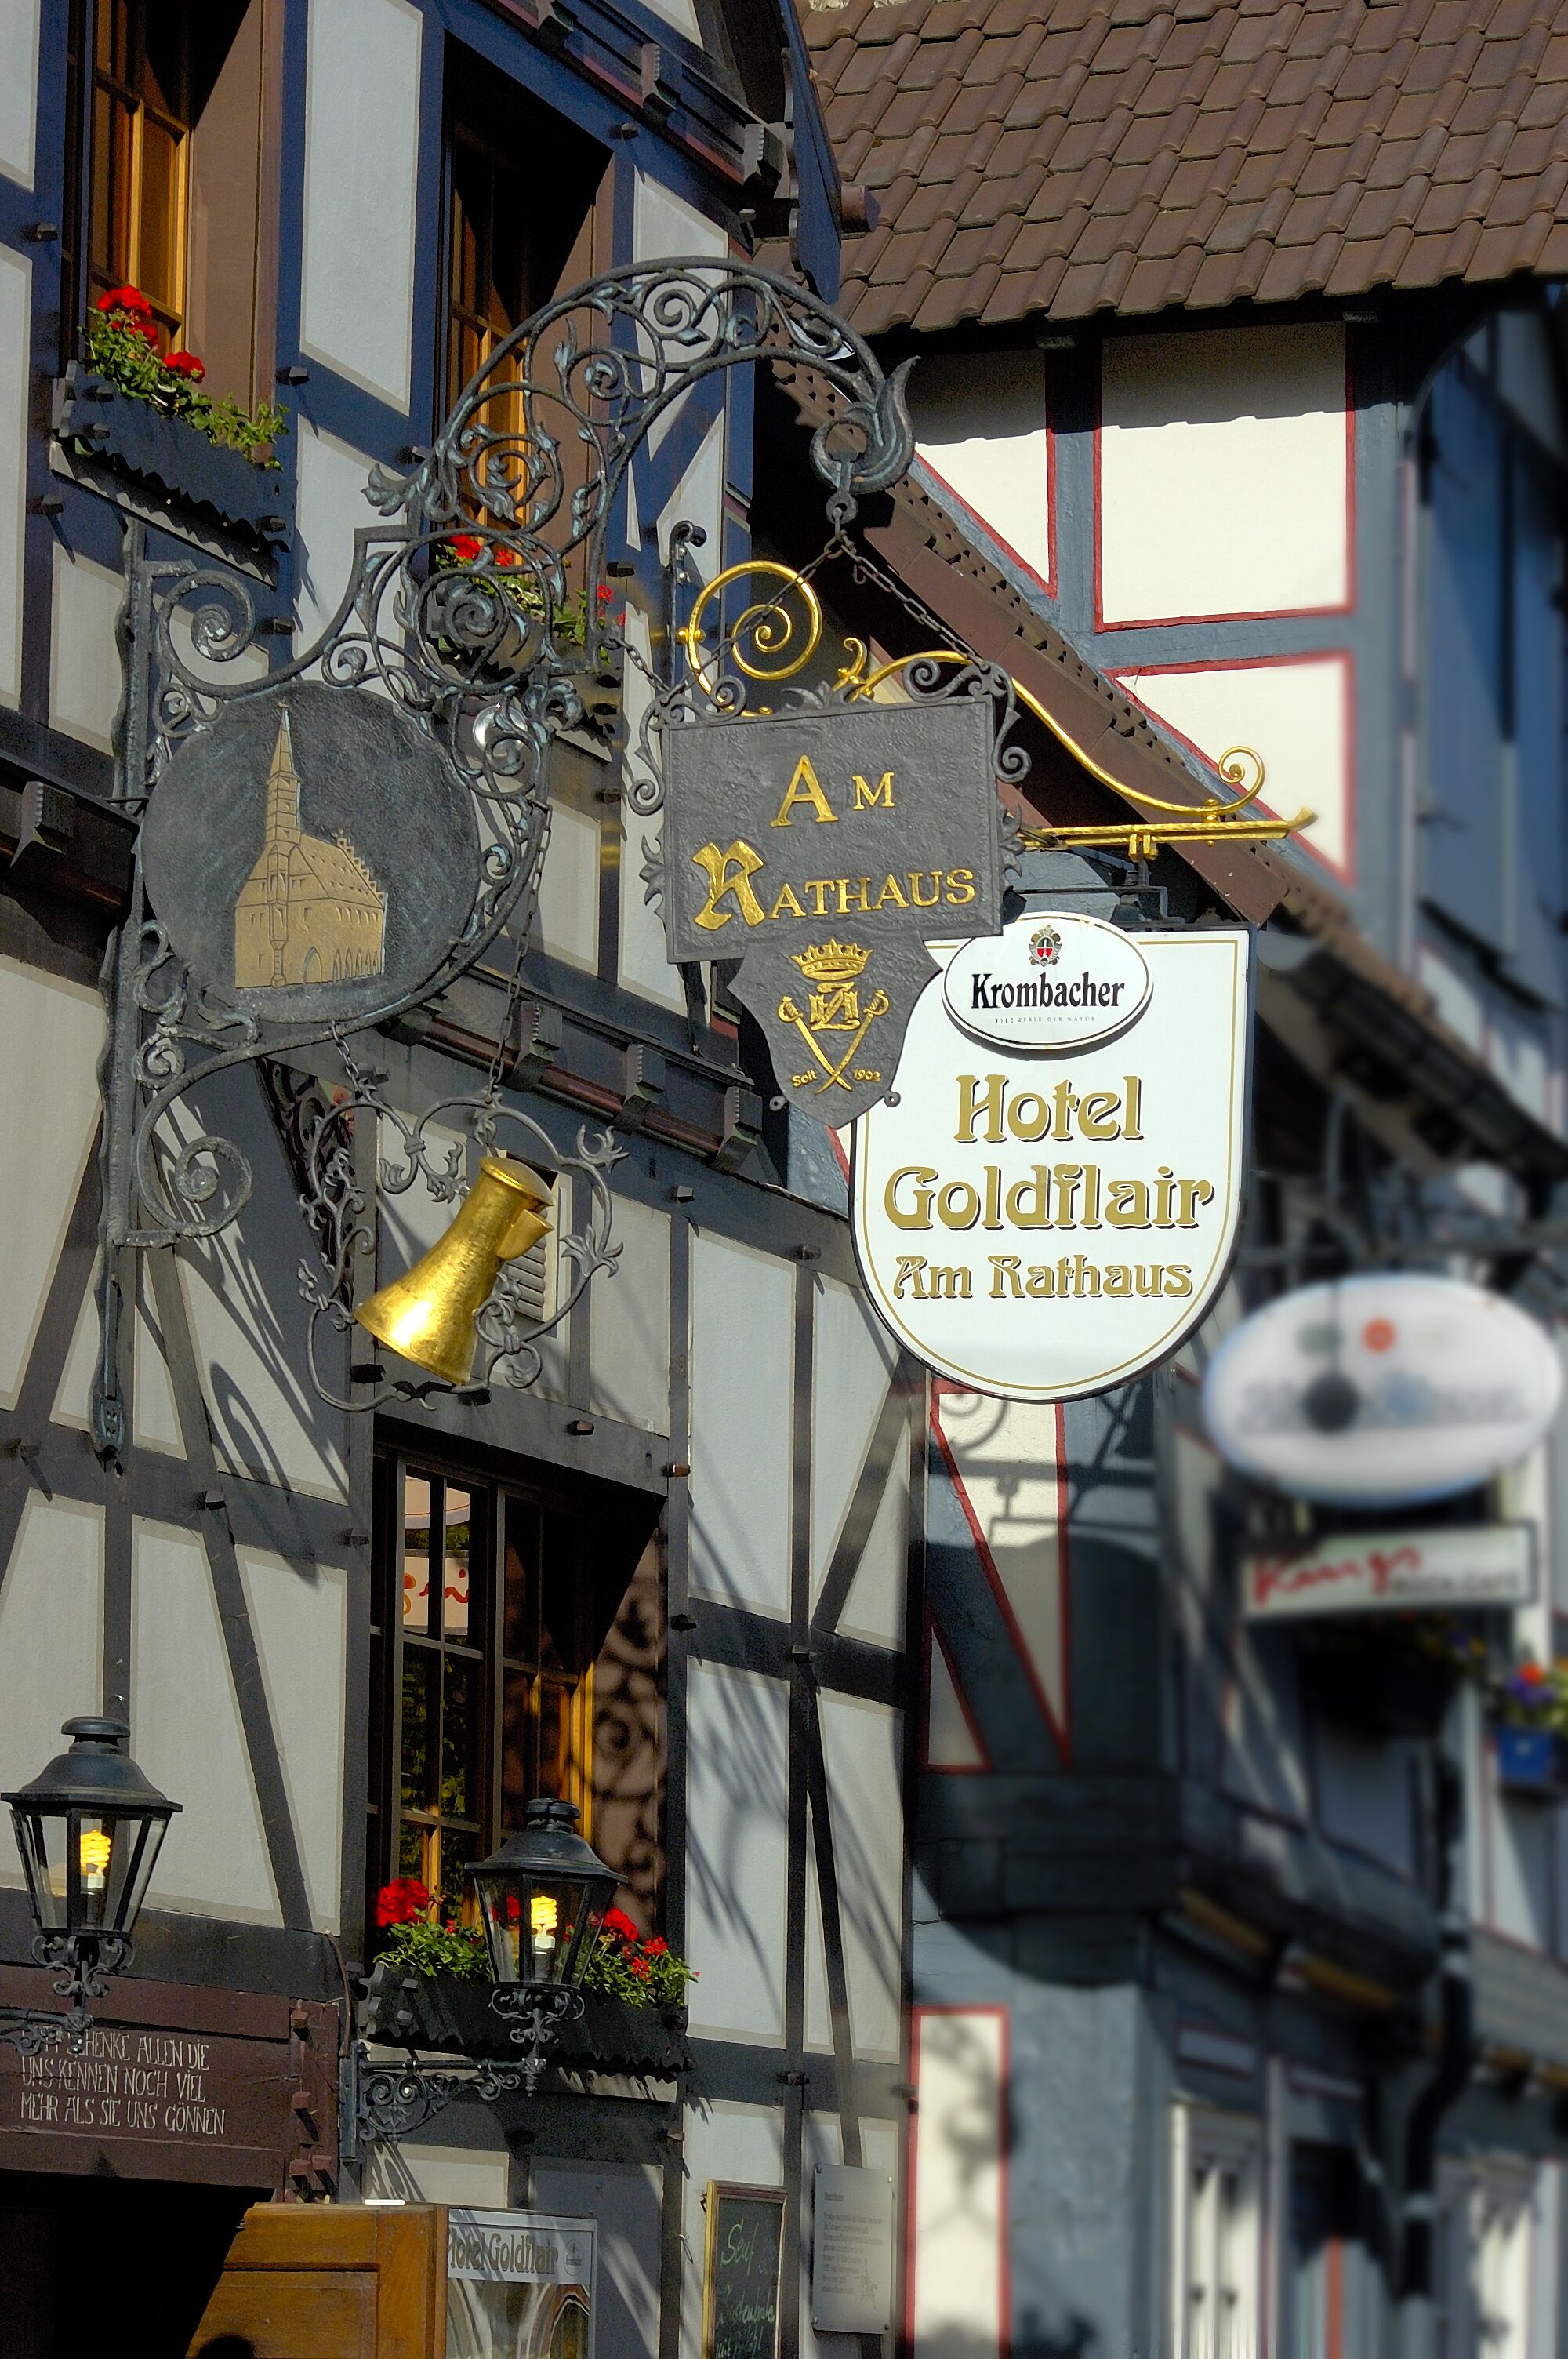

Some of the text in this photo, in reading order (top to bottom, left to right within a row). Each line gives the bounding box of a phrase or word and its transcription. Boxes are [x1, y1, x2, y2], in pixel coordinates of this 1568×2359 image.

[692, 840, 977, 932] RATHAUS
[971, 971, 1126, 1009] Krombacher
[852, 1068, 881, 1083] 1902
[953, 1074, 1144, 1143] Hotel
[884, 1164, 1216, 1231] Goldflair
[892, 1254, 1195, 1299] Am Rathaus
[67, 2029, 131, 2061] HENKE
[137, 2036, 183, 2067] ALLEN
[188, 2039, 209, 2071] DIE
[21, 2055, 206, 2103] UNS KENNEN NOCH VIEL
[20, 2092, 225, 2135] MEHR ALS SIE UNS GÖNNEN
[489, 2233, 559, 2275] Goldflair
